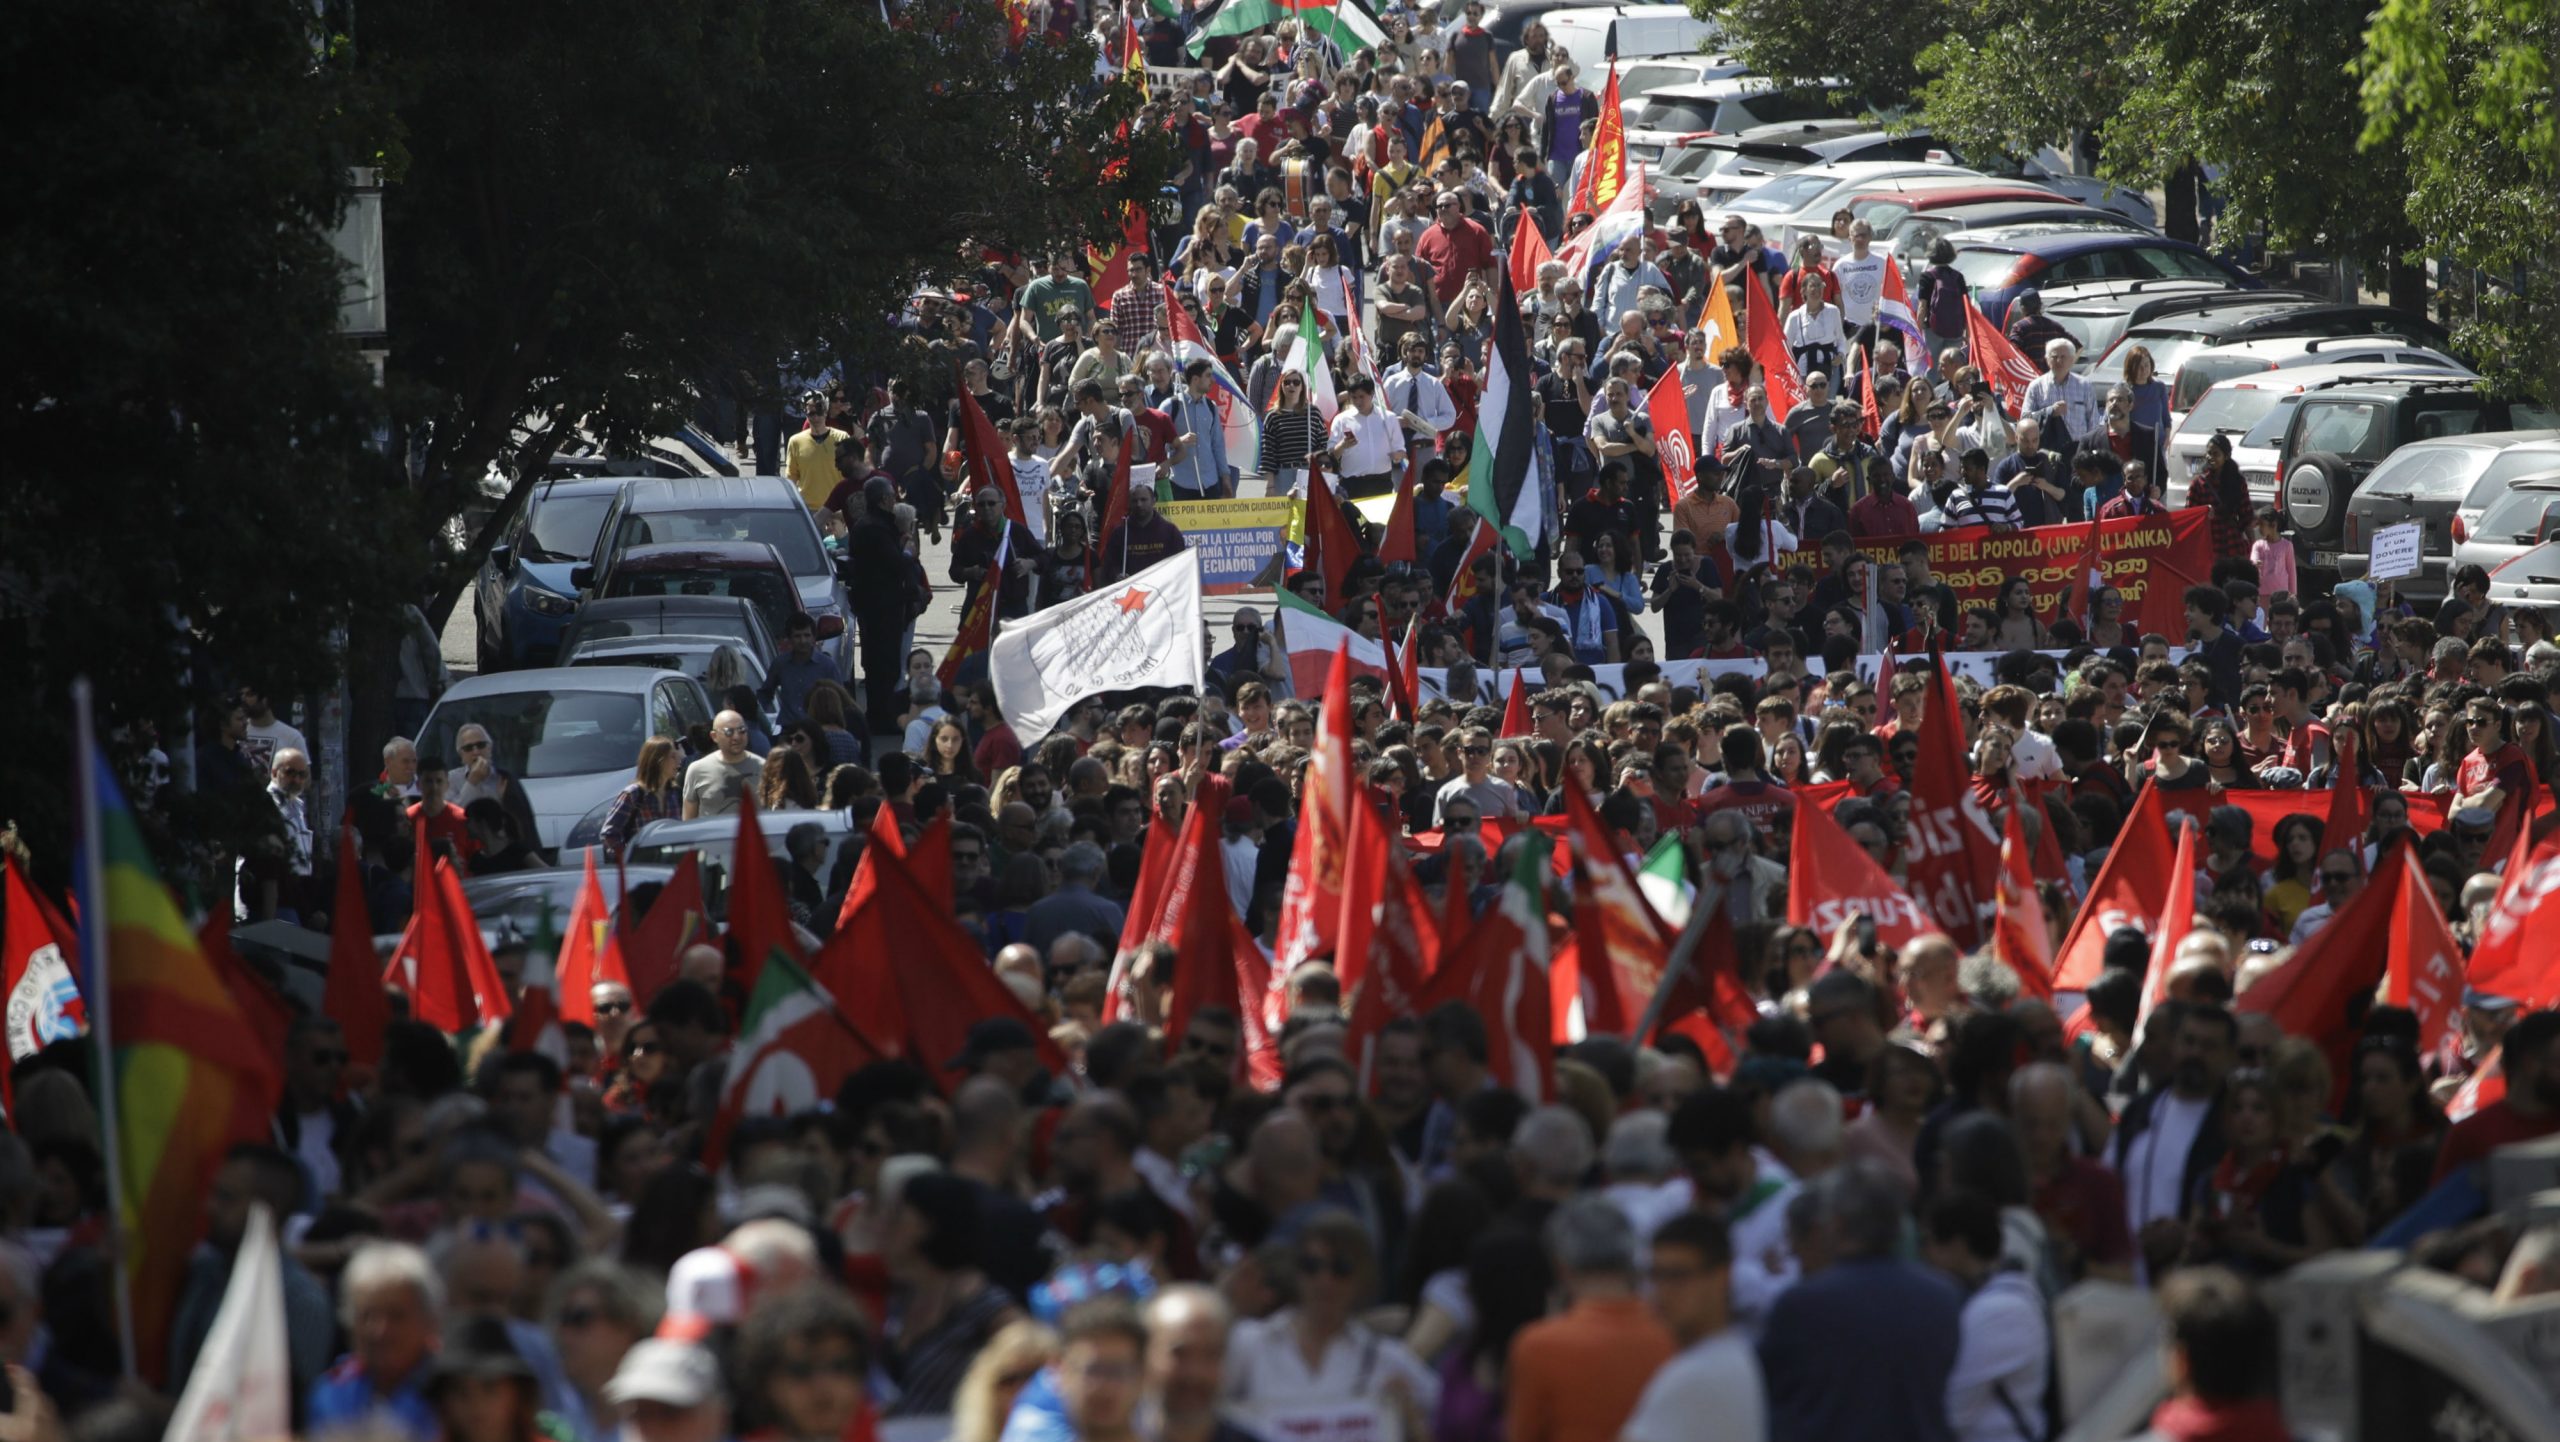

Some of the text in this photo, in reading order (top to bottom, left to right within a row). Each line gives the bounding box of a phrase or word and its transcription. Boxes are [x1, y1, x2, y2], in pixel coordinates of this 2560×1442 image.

[2291, 487, 2321, 495] SUZUKI
[1157, 501, 1291, 516] ANTES POR LA REVOLUCIÓN CIUDADANA
[1210, 533, 1223, 545] LA
[1224, 531, 1255, 544] LUCHA
[1256, 531, 1274, 543] POR
[2393, 538, 2406, 546] UN
[1225, 546, 1232, 557] Y
[1234, 543, 1277, 557] DIGNIDAD
[1776, 549, 1817, 570] ONTE
[1949, 541, 1979, 563] DEL
[1982, 538, 2042, 559] POPOLO
[2115, 528, 2173, 550] LANKA)
[2375, 546, 2414, 560] DOVERE
[1203, 558, 1256, 574] ECUADOR
